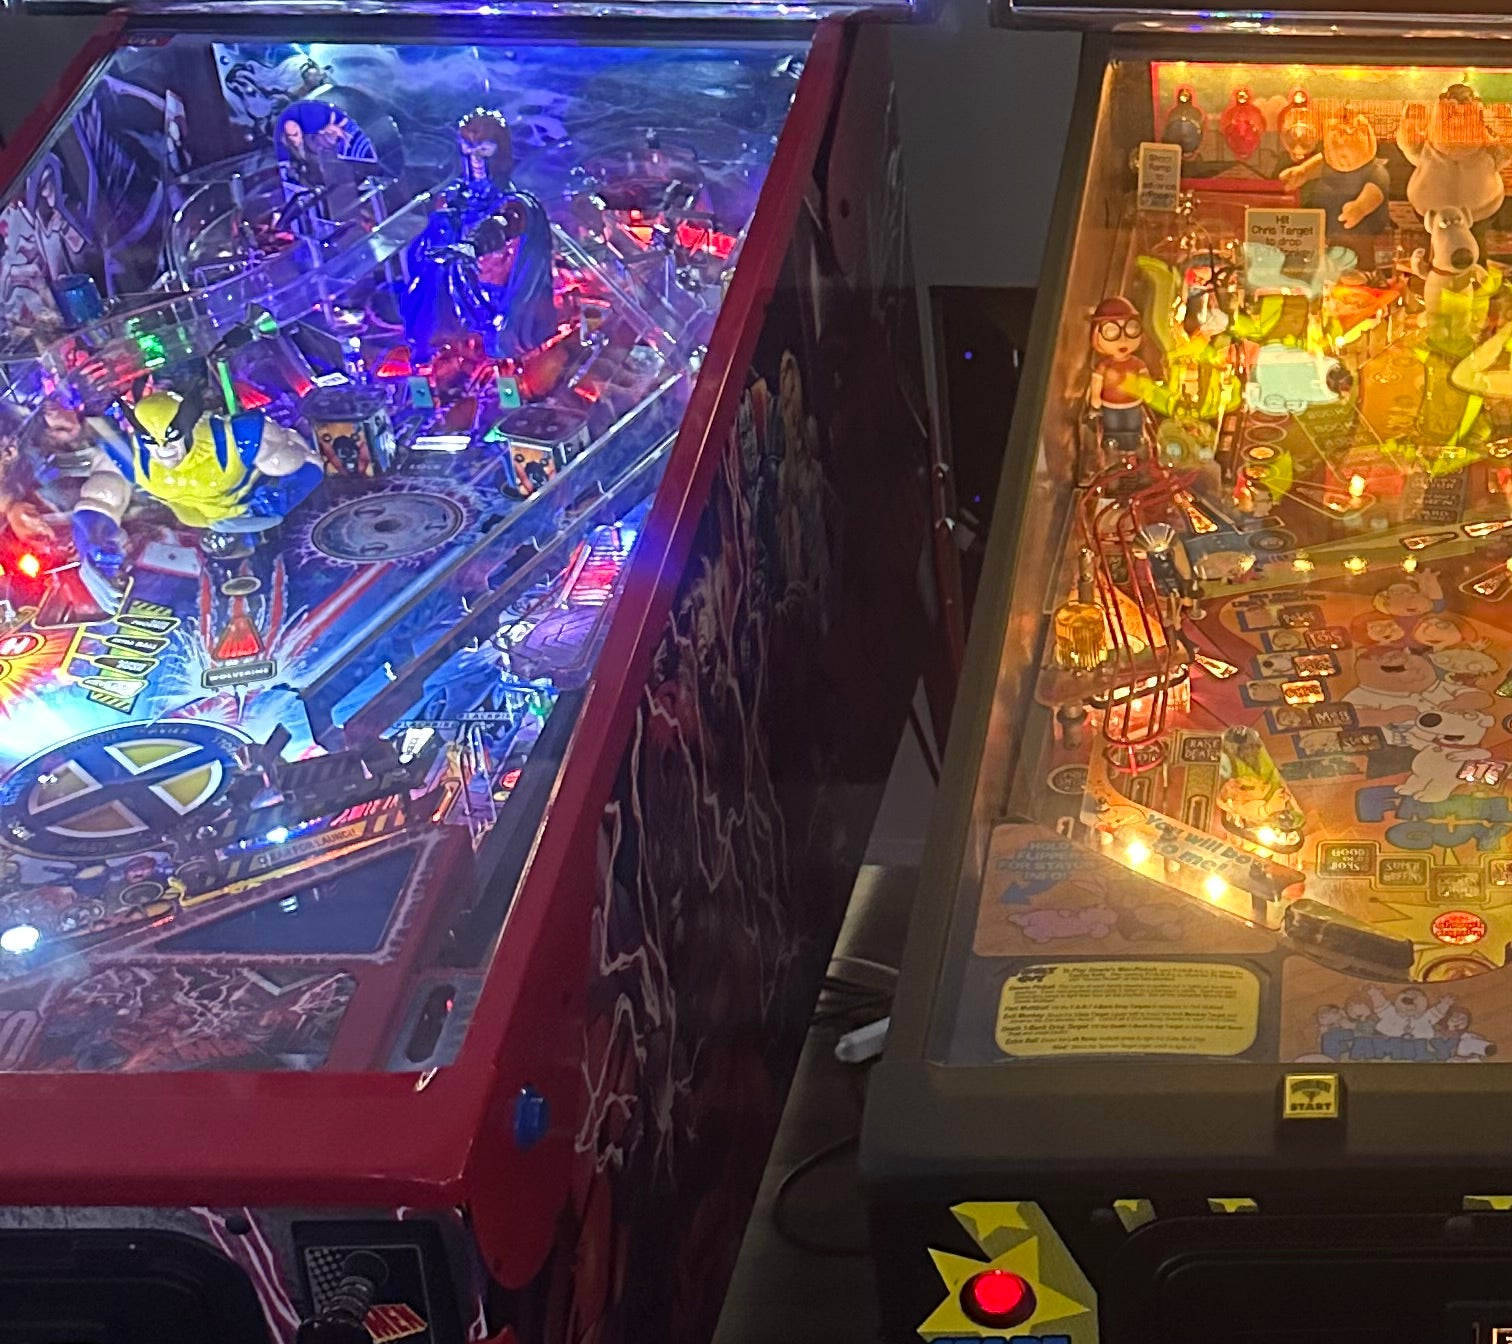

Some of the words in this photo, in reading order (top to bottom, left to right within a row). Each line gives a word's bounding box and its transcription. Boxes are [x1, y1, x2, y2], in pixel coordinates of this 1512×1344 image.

[1276, 215, 1290, 225] Hit
[1251, 225, 1277, 235] Chris
[1280, 226, 1314, 237] Target
[1279, 237, 1302, 248] drop
[1030, 842, 1070, 851] HOLD
[1185, 831, 1224, 853] will
[1321, 1029, 1462, 1061] FAMILY
[1290, 1103, 1332, 1112] START
